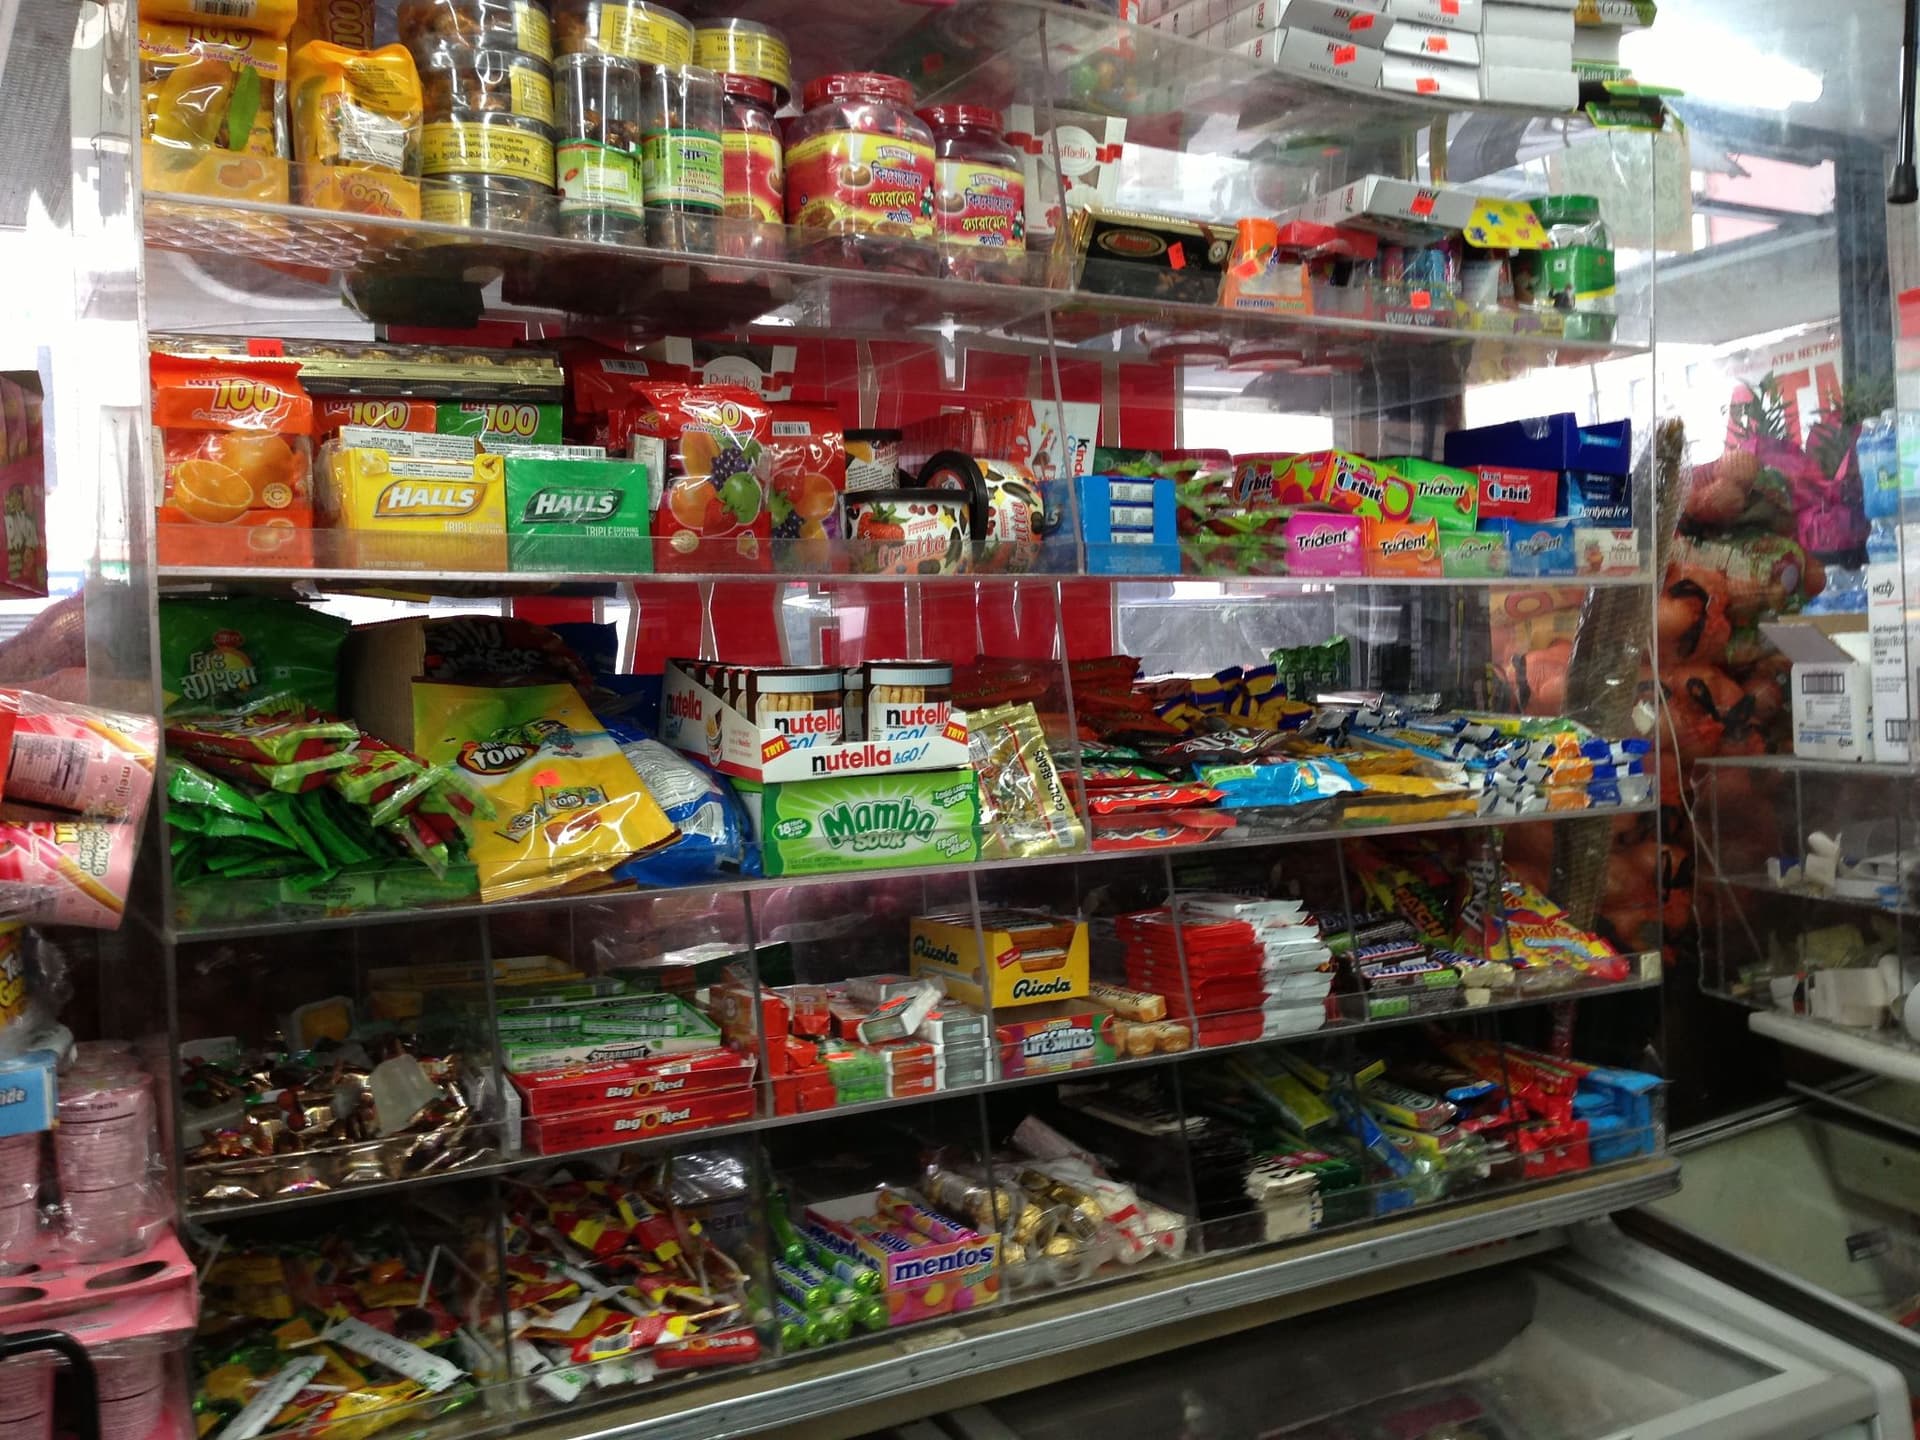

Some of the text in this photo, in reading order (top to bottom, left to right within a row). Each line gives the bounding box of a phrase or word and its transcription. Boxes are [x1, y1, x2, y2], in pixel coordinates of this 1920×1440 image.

[1771, 351, 1795, 366] ATM
[708, 373, 756, 391] Raffaello
[211, 377, 282, 414] 100
[350, 400, 409, 431] 100
[483, 401, 540, 438] 100
[1074, 437, 1091, 477] Kind
[1238, 467, 1273, 502] Orbit
[1337, 471, 1383, 503] Orbit
[1417, 481, 1464, 498] Trident
[1487, 483, 1531, 503] Orbit
[387, 486, 477, 509] HALLS
[534, 492, 615, 516] HALLS
[1296, 529, 1349, 550] Trident
[1380, 534, 1427, 556] Trident
[666, 689, 703, 721] nutella
[886, 700, 951, 727] nutella
[774, 707, 842, 735] nutella
[947, 725, 967, 741] TRY!
[763, 742, 785, 759] TRY!
[812, 744, 892, 773] nutella
[115, 766, 132, 798] meiji
[777, 821, 791, 835] 18
[820, 796, 937, 848] Mamba
[853, 830, 907, 852] SOUR
[913, 935, 959, 965] Ricola
[1013, 976, 1071, 999] Ricola
[591, 1047, 646, 1062] SPEARMINT
[653, 1078, 684, 1092] Red
[661, 1108, 690, 1122] Red
[895, 1245, 996, 1283] mentos
